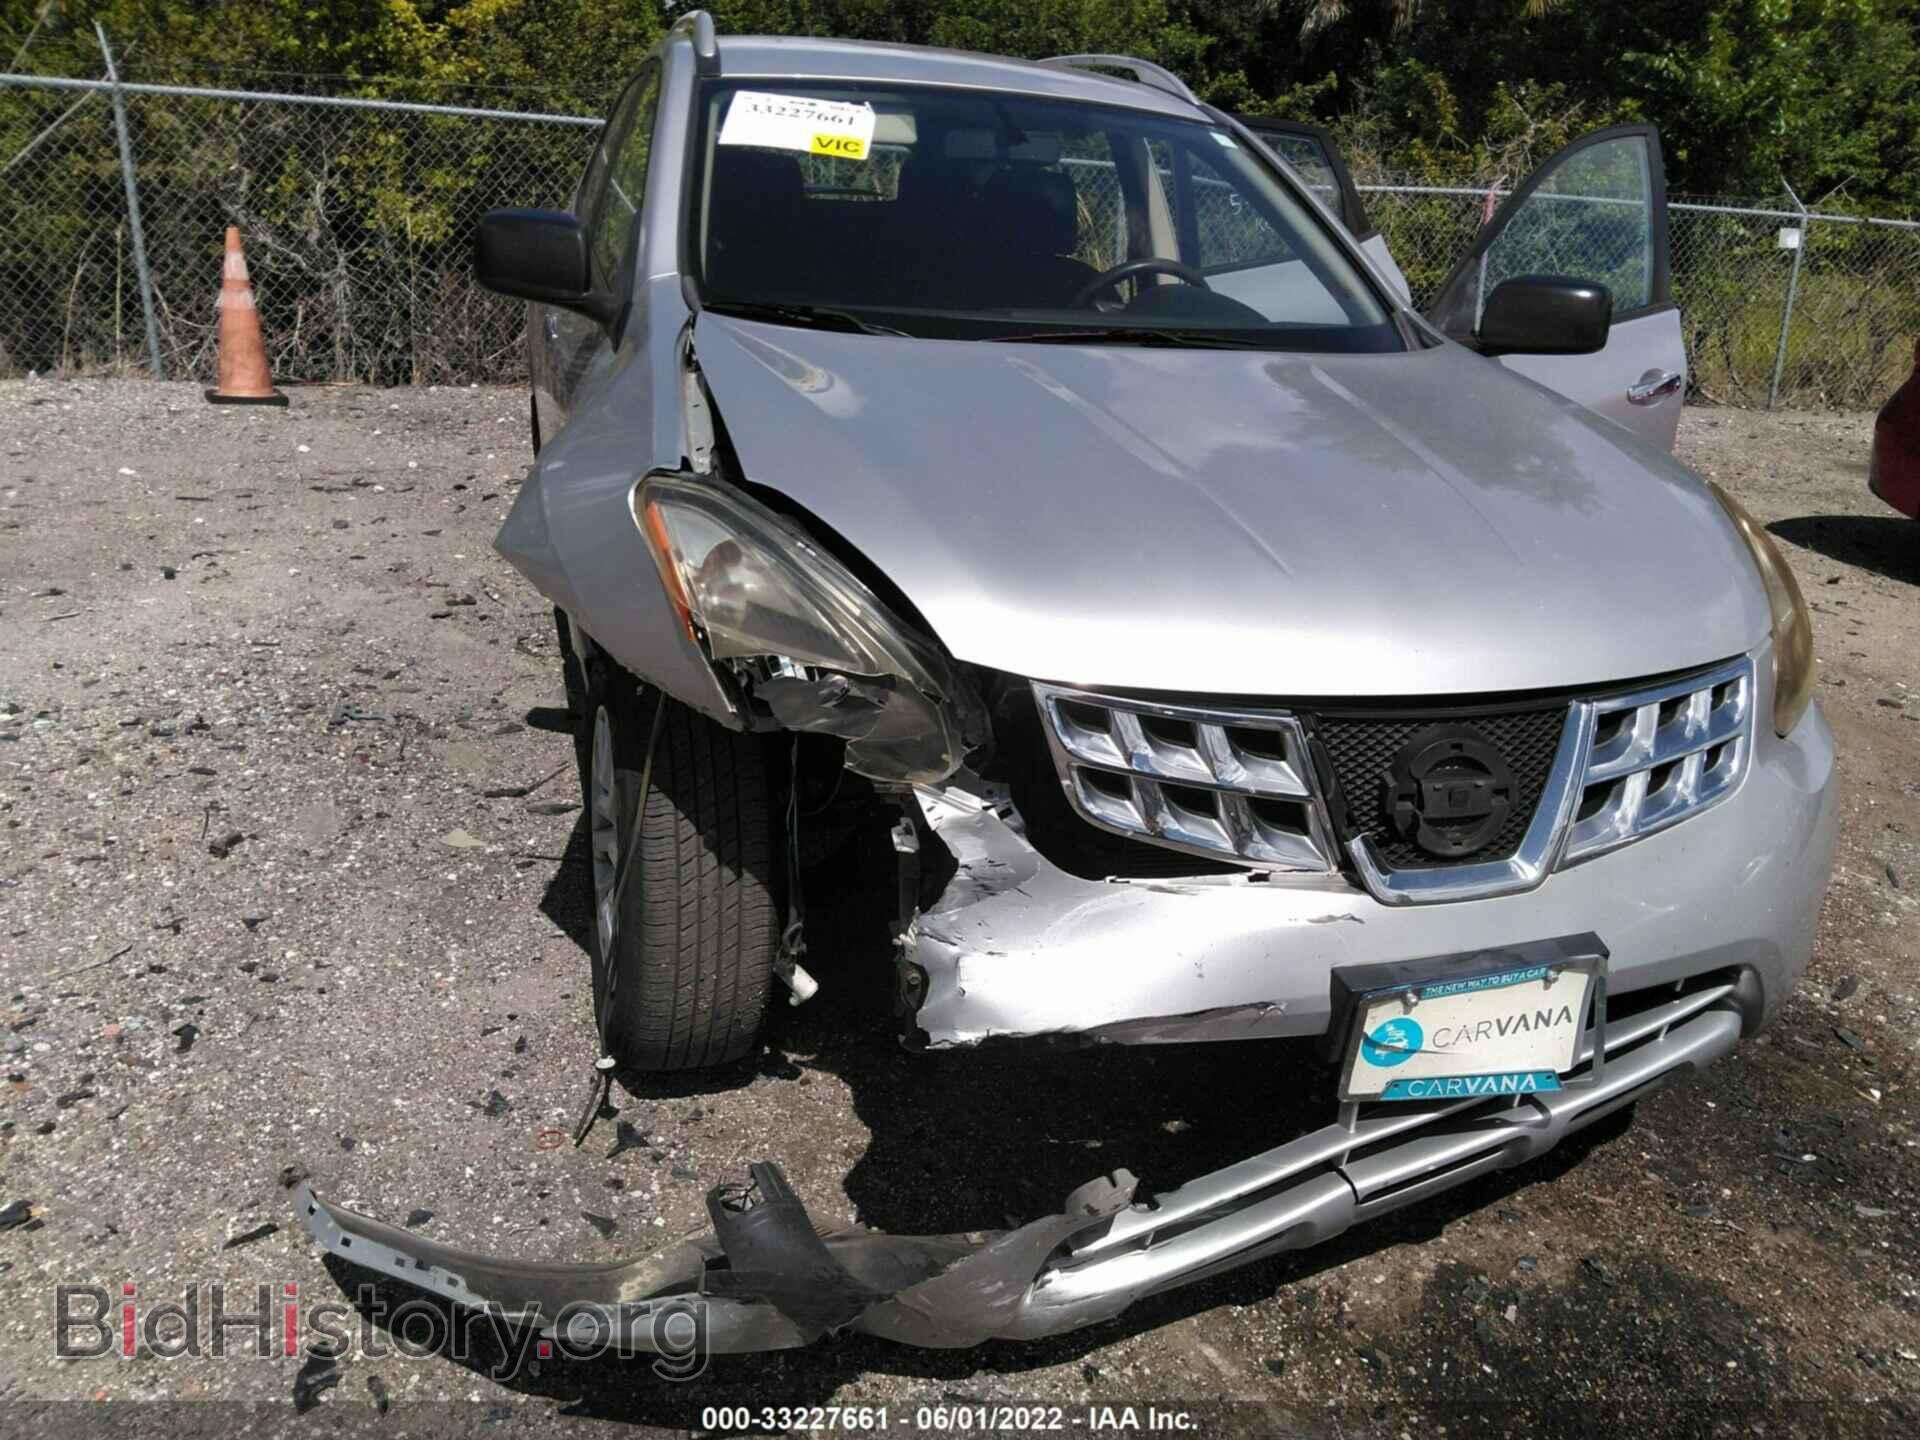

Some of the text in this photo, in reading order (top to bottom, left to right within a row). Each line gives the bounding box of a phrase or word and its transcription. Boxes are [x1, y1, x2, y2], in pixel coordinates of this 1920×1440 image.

[744, 103, 854, 125] 33227661
[816, 136, 861, 153] VIC
[1425, 986, 1442, 995] THE
[1444, 981, 1466, 992] NEW
[1487, 976, 1500, 985] TO
[1432, 1005, 1573, 1048] CARVANA
[1407, 1073, 1537, 1097] CARVANA
